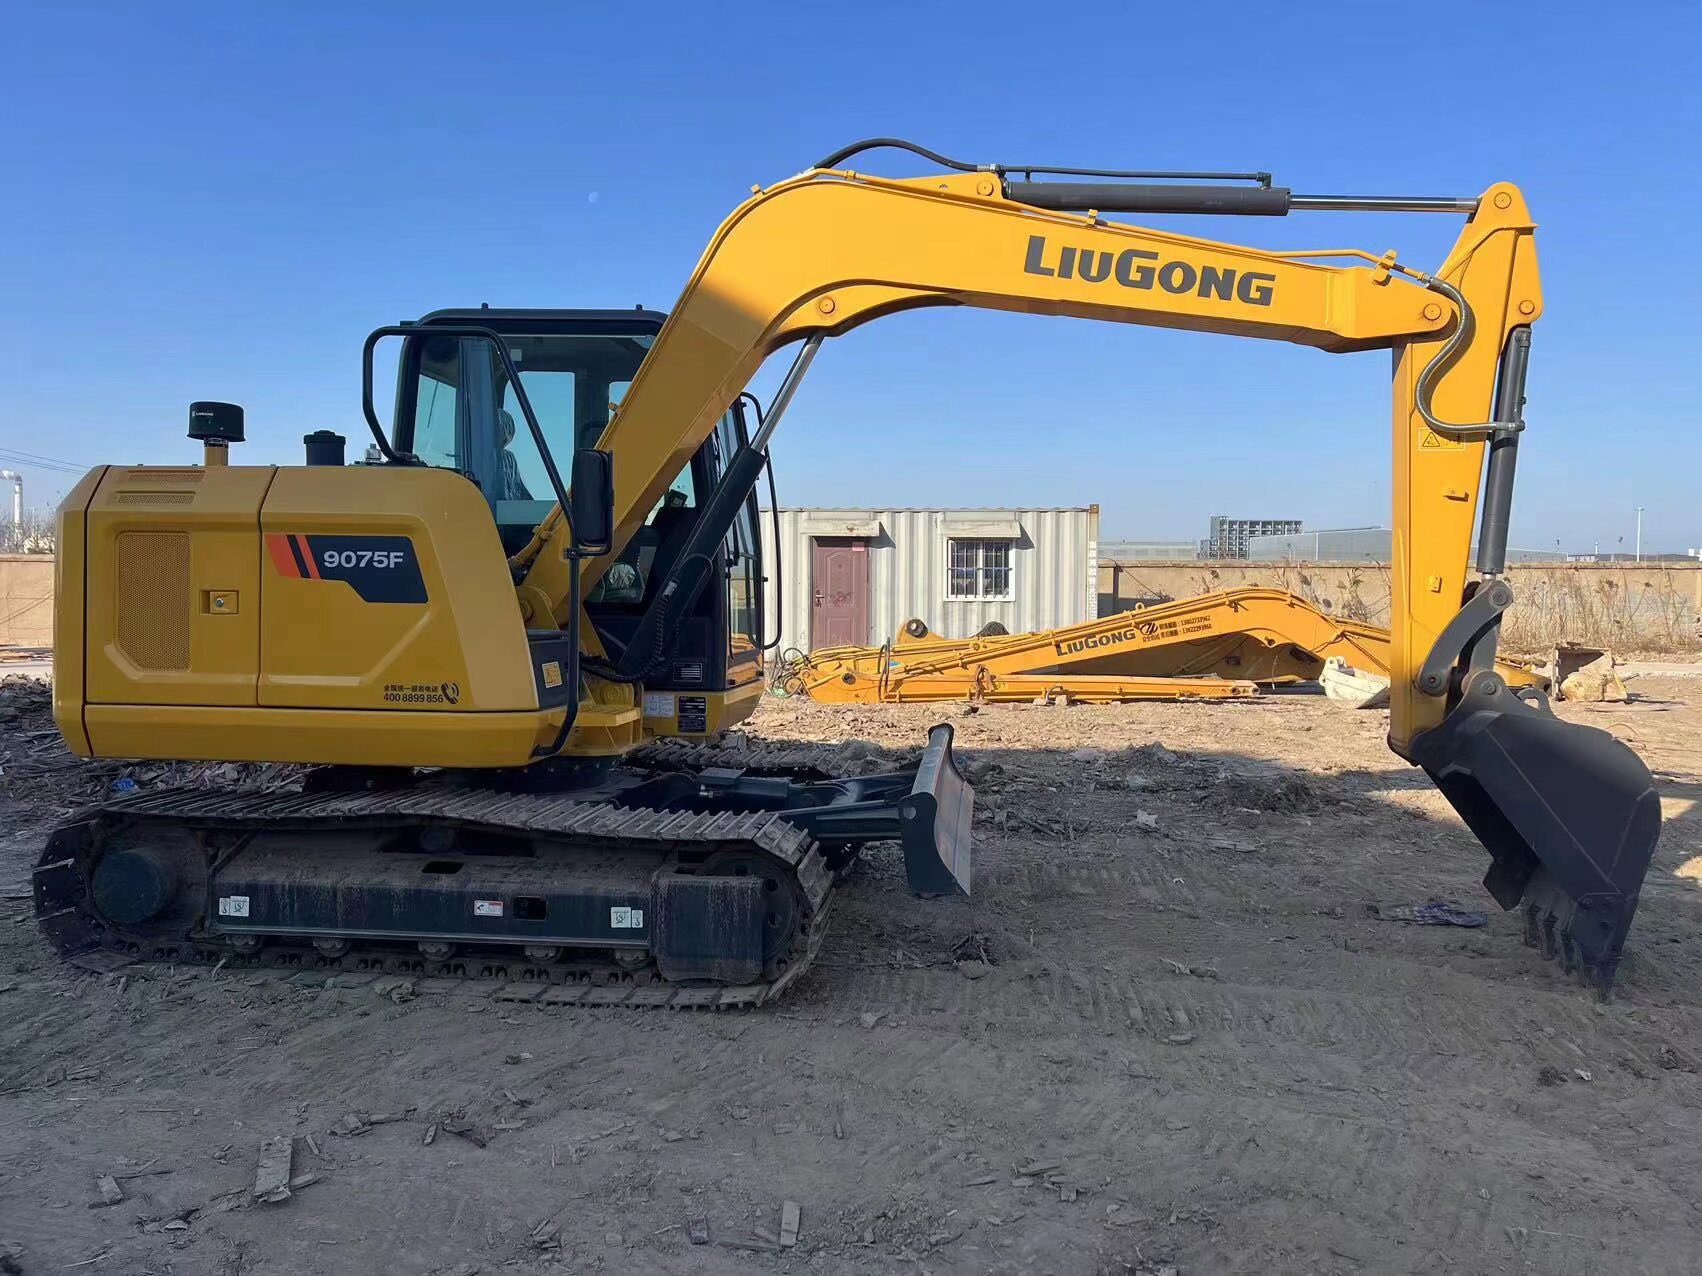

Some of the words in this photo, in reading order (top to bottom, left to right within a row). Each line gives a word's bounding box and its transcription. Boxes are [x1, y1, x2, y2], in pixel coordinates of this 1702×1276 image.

[323, 550, 404, 568] 9075F
[383, 693, 400, 701] 400
[402, 693, 425, 702] 8899
[426, 694, 443, 703] 856
